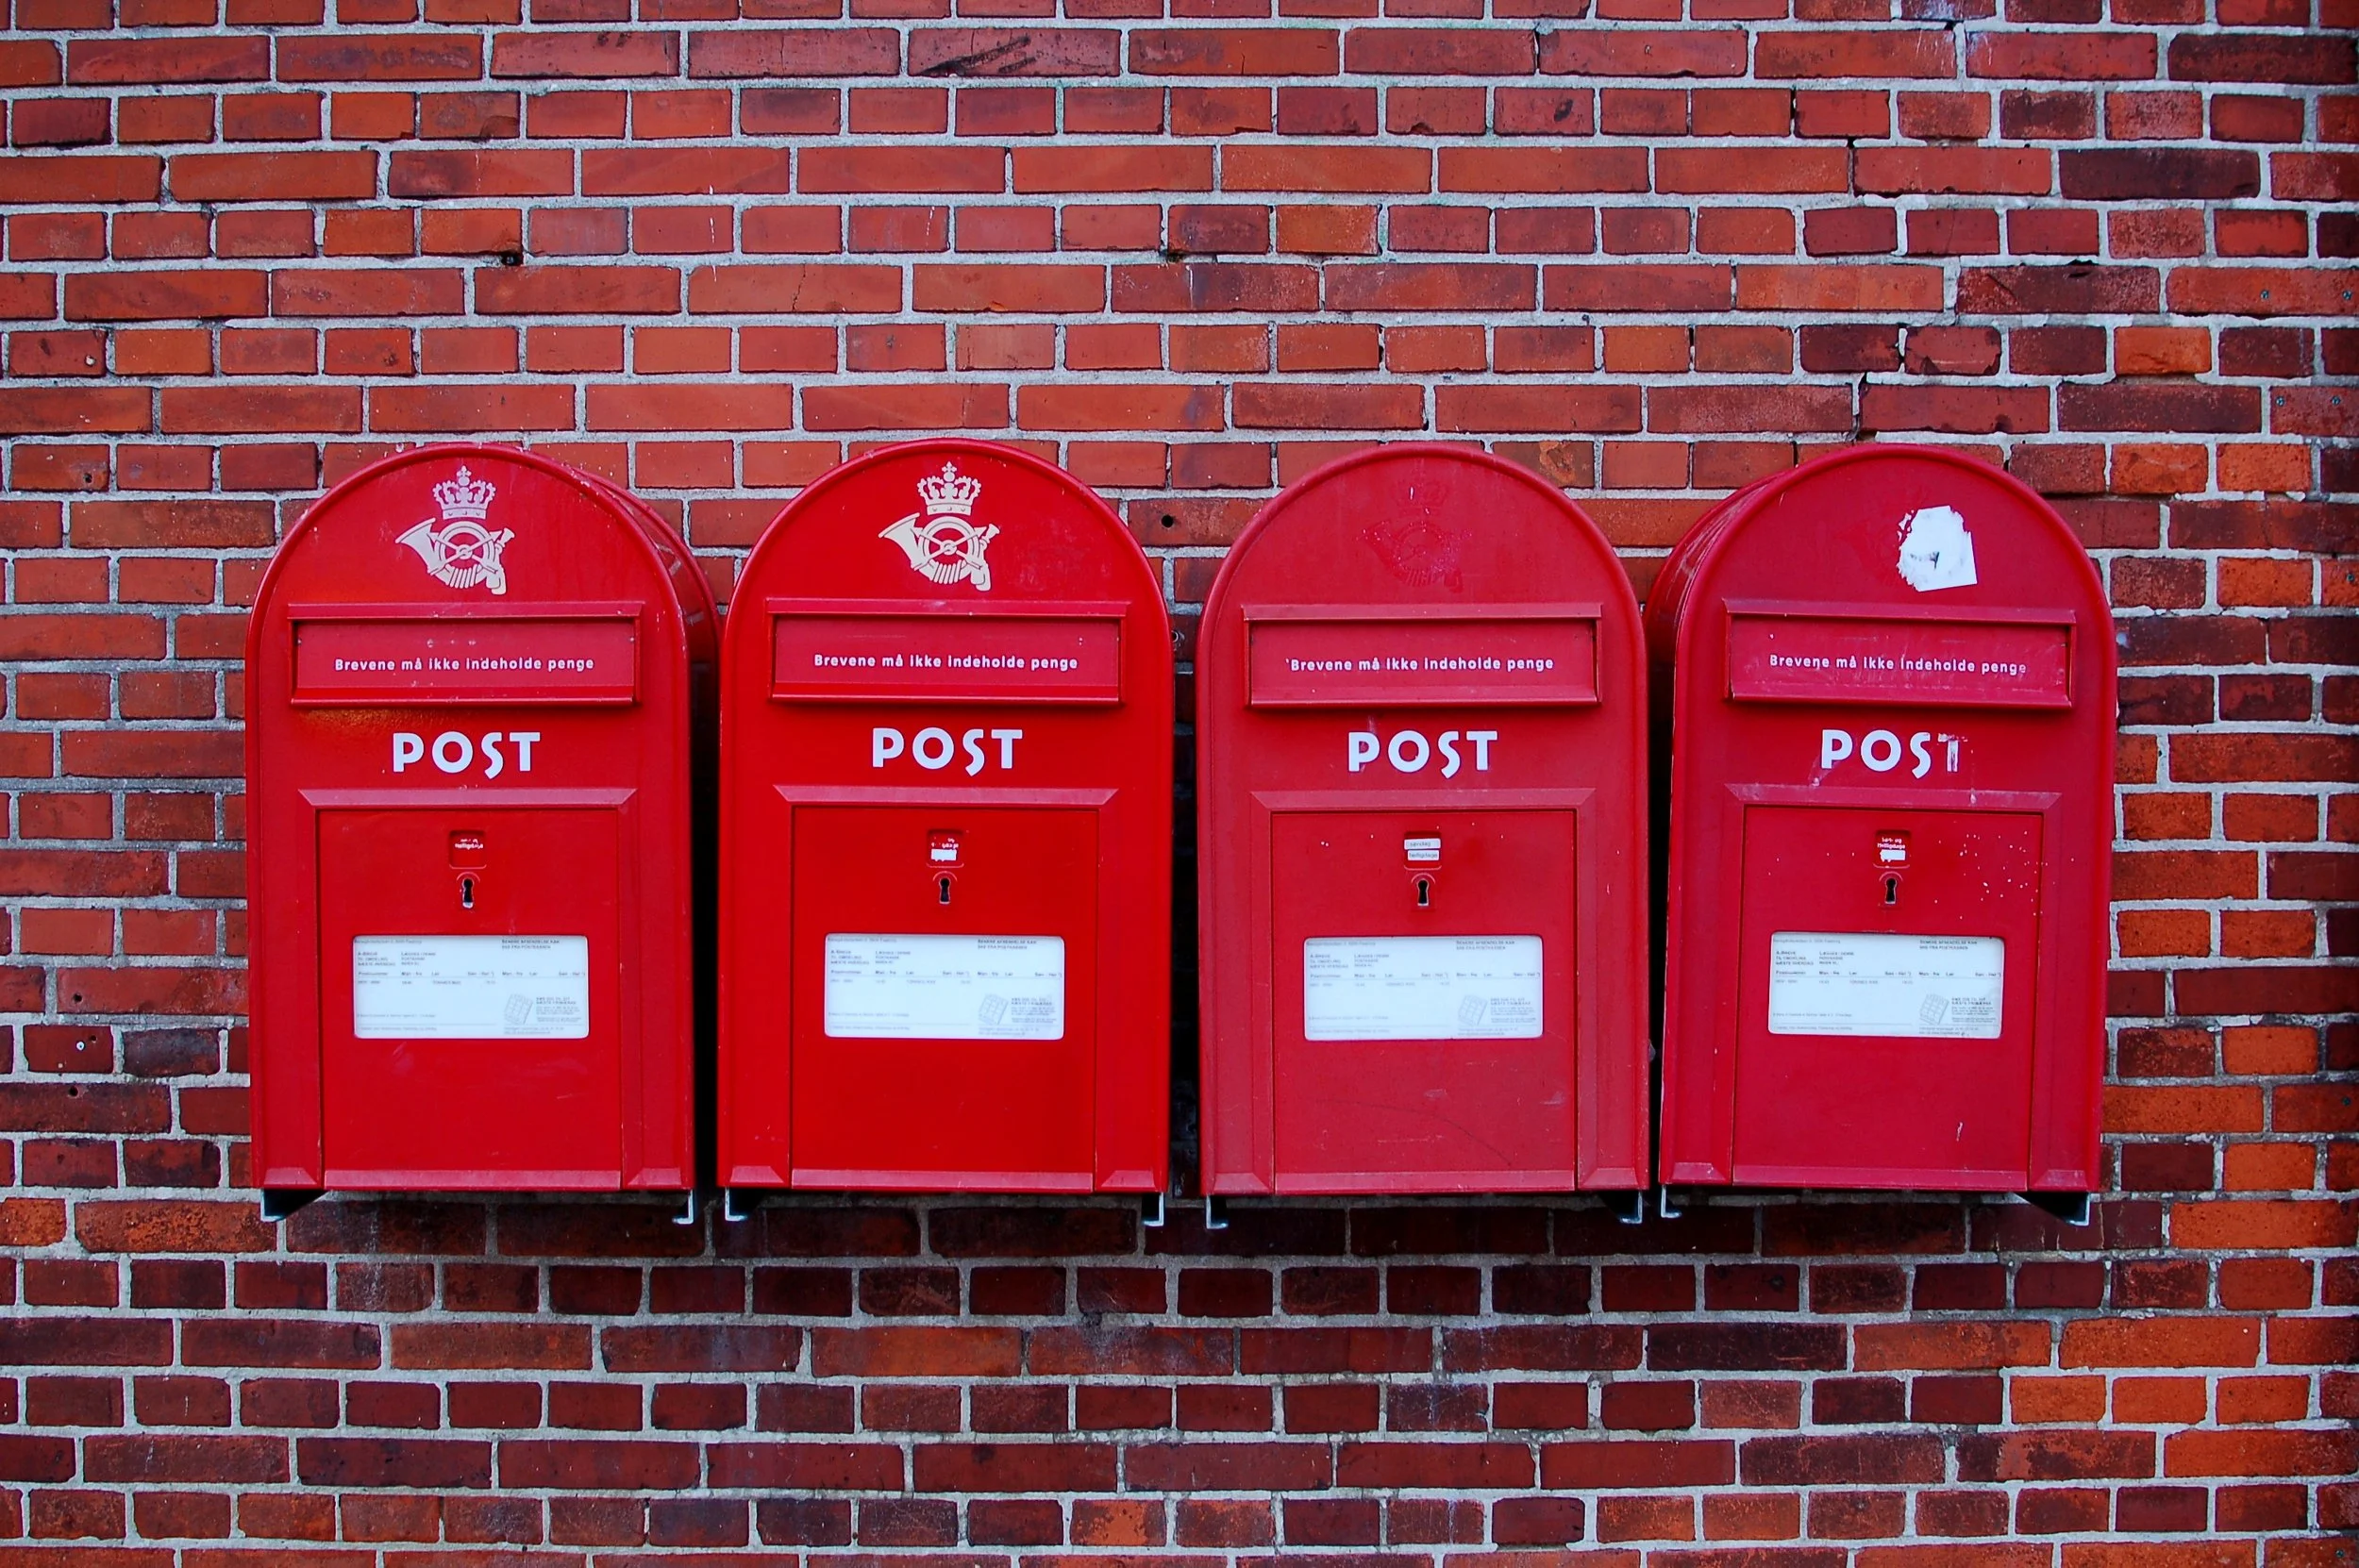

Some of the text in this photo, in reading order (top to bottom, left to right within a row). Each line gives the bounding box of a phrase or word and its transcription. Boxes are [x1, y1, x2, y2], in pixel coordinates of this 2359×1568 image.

[335, 656, 594, 672] Brevene må ikke indeholde penge
[814, 654, 1078, 672] Brevene må ikke indeholde penge
[1291, 657, 1554, 673] Brevene må ikke indeholde penge
[1769, 654, 2027, 676] Brevene må ikke indeholde penge
[393, 731, 541, 779] POST
[872, 726, 1023, 776] POST
[1348, 730, 1498, 779] POST
[1821, 729, 1968, 779] POST
